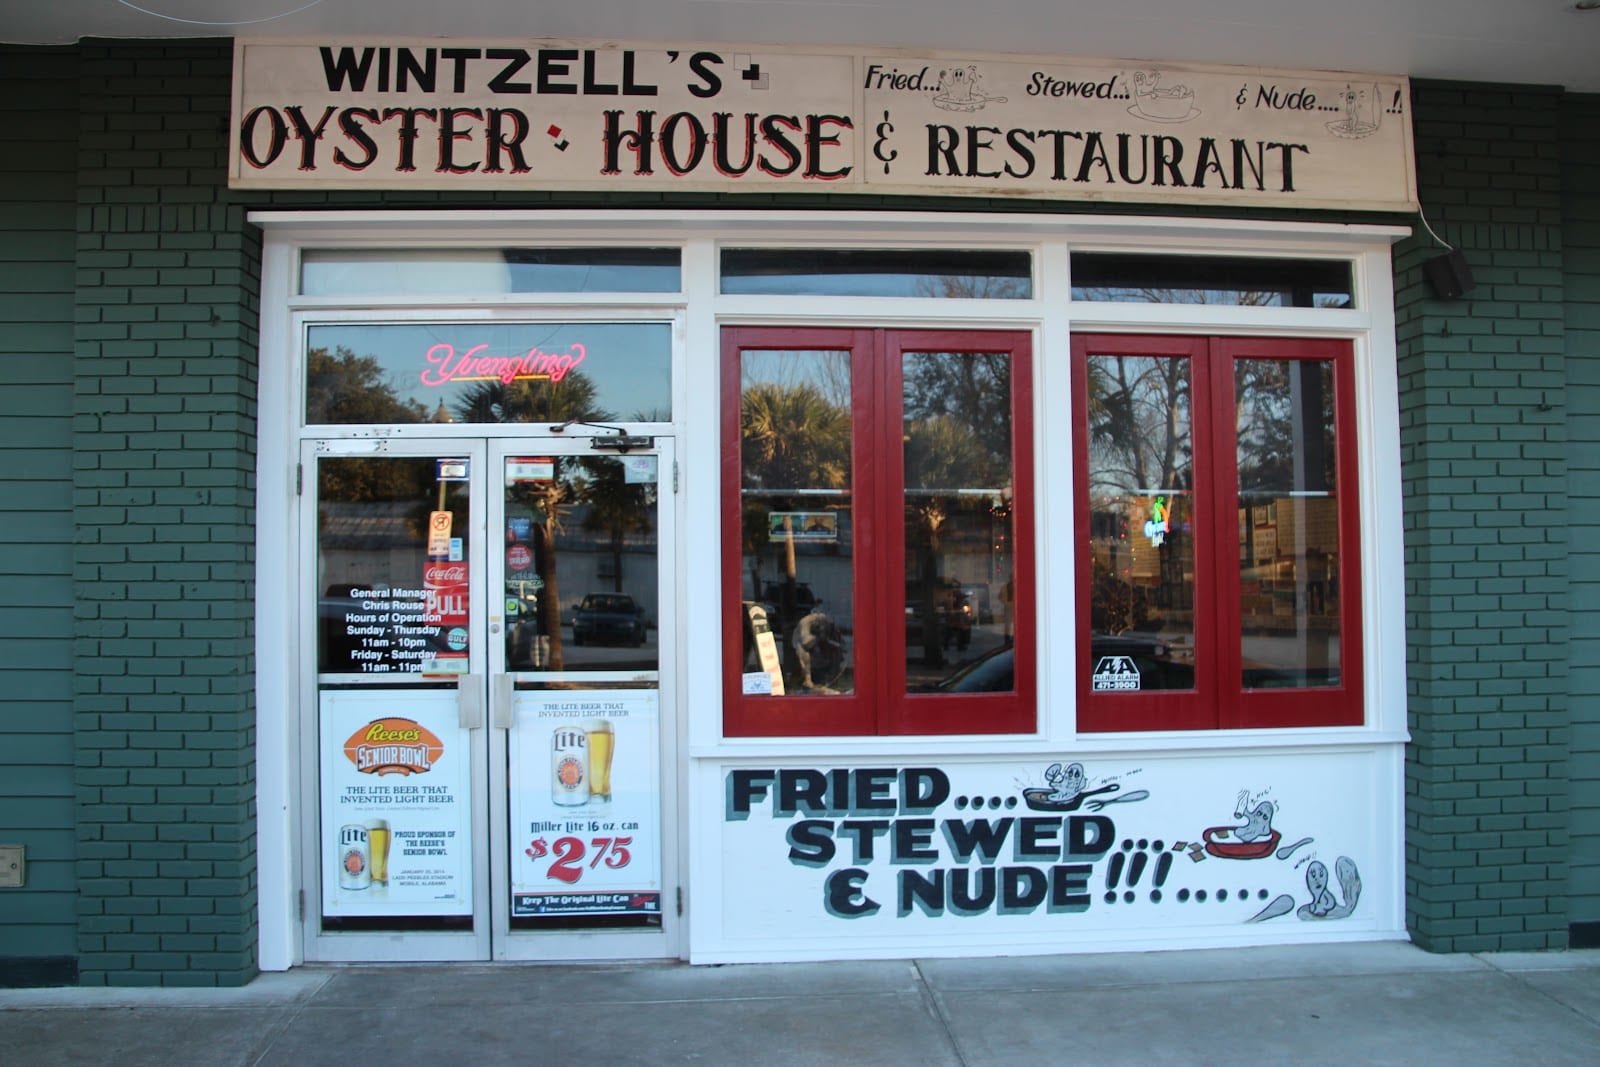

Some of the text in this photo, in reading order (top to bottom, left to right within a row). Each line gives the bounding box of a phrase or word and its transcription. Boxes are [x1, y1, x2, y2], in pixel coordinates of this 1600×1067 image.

[319, 46, 725, 98] WINTZELL'S
[1236, 83, 1247, 110] &
[240, 106, 1310, 193] OYSTER HOUSE & RESTAURANT
[420, 343, 587, 386] Yuengling
[350, 588, 437, 601] General Manager
[362, 601, 425, 611] Chris Rouse
[426, 594, 466, 616] PULL
[345, 613, 442, 624] Hours of Operation
[346, 625, 385, 637] Sunday
[394, 625, 441, 637] Thursday
[362, 638, 389, 648] 11am
[399, 638, 426, 650] 10pm
[351, 650, 383, 661] Friday
[391, 650, 437, 661] Saturday
[361, 663, 389, 672] 11am
[365, 723, 421, 743] Reese's
[554, 732, 586, 751] Lite
[359, 745, 431, 769] SENIOR BOWL
[346, 786, 448, 795] THE LITE BEER THAT
[340, 794, 454, 804] INVENTED LIGHT BEER
[531, 821, 562, 834] Miller
[566, 821, 584, 833] Lite
[588, 821, 599, 832] 16
[621, 822, 639, 830] can
[403, 848, 426, 856] SENIOR
[561, 895, 595, 905] Original
[613, 894, 629, 903] Can
[824, 868, 881, 919] &
